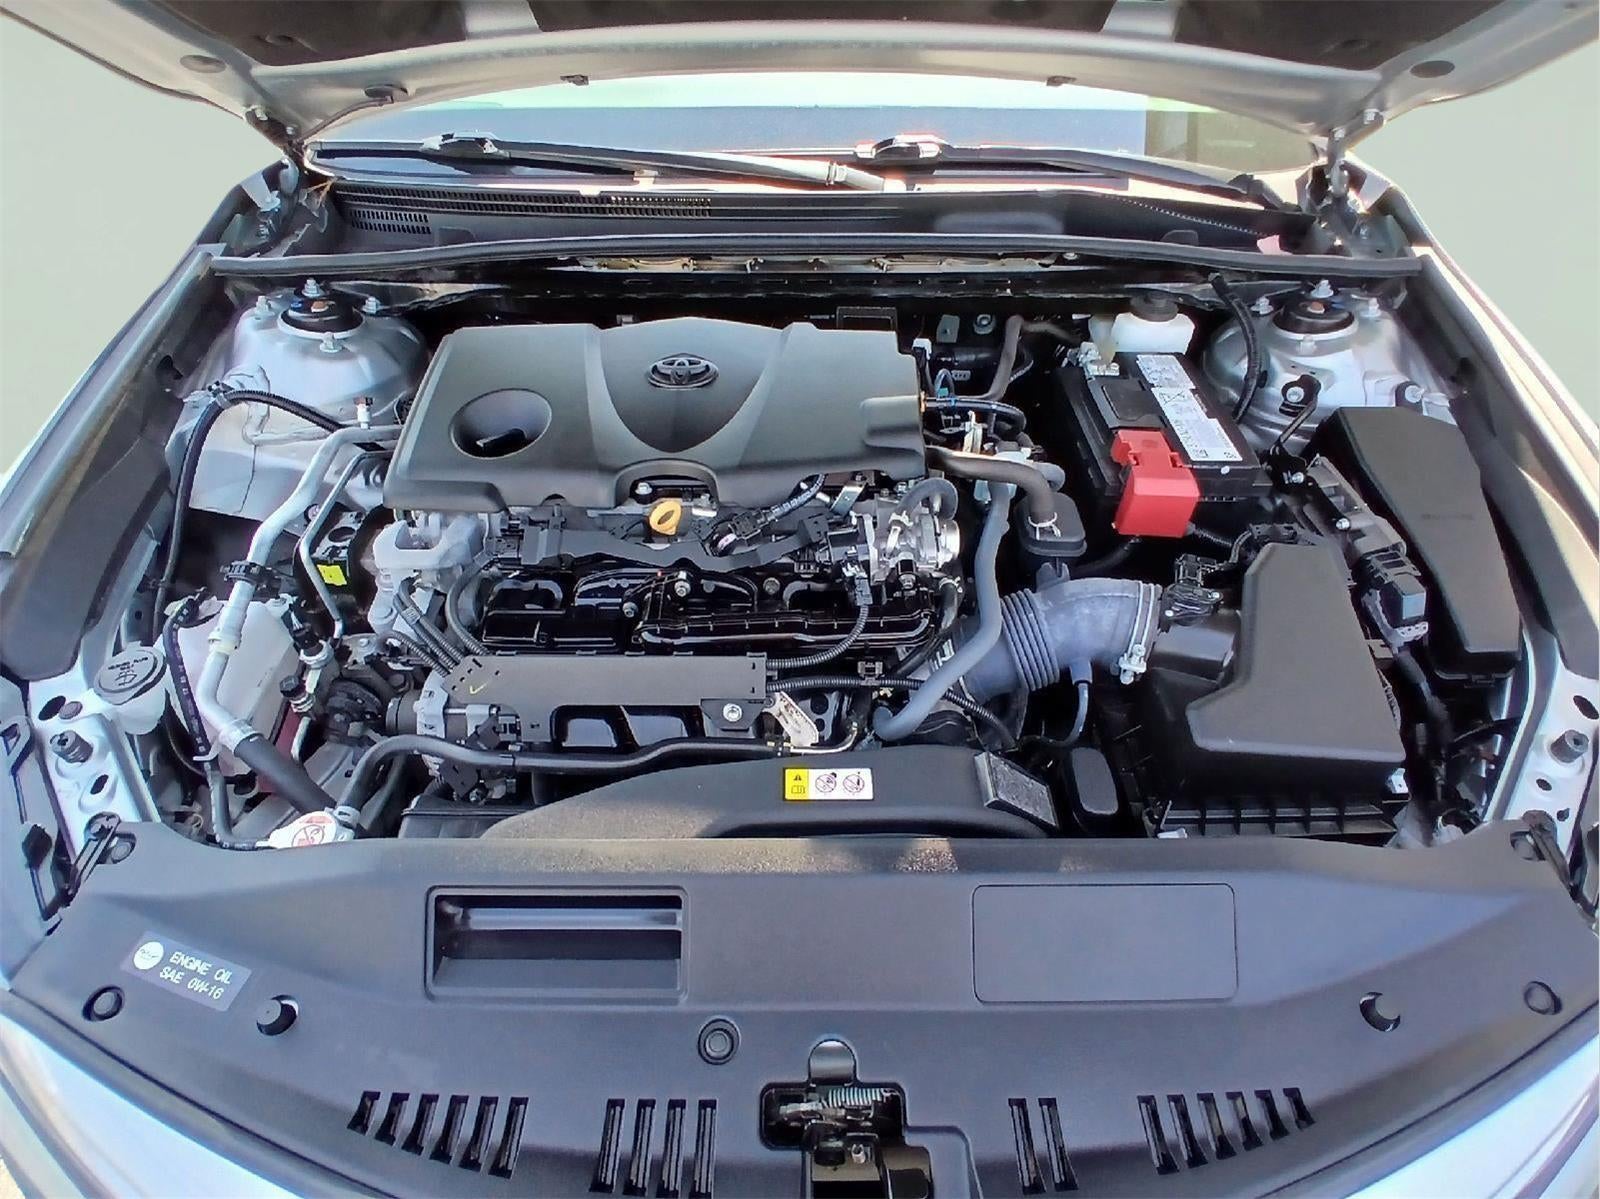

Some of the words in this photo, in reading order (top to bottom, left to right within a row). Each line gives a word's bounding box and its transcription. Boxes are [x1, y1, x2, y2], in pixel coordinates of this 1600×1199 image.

[159, 966, 185, 984] SAE
[187, 977, 225, 1000] 0W-16
[169, 951, 213, 976] ENGINE
[214, 968, 233, 985] OIL
